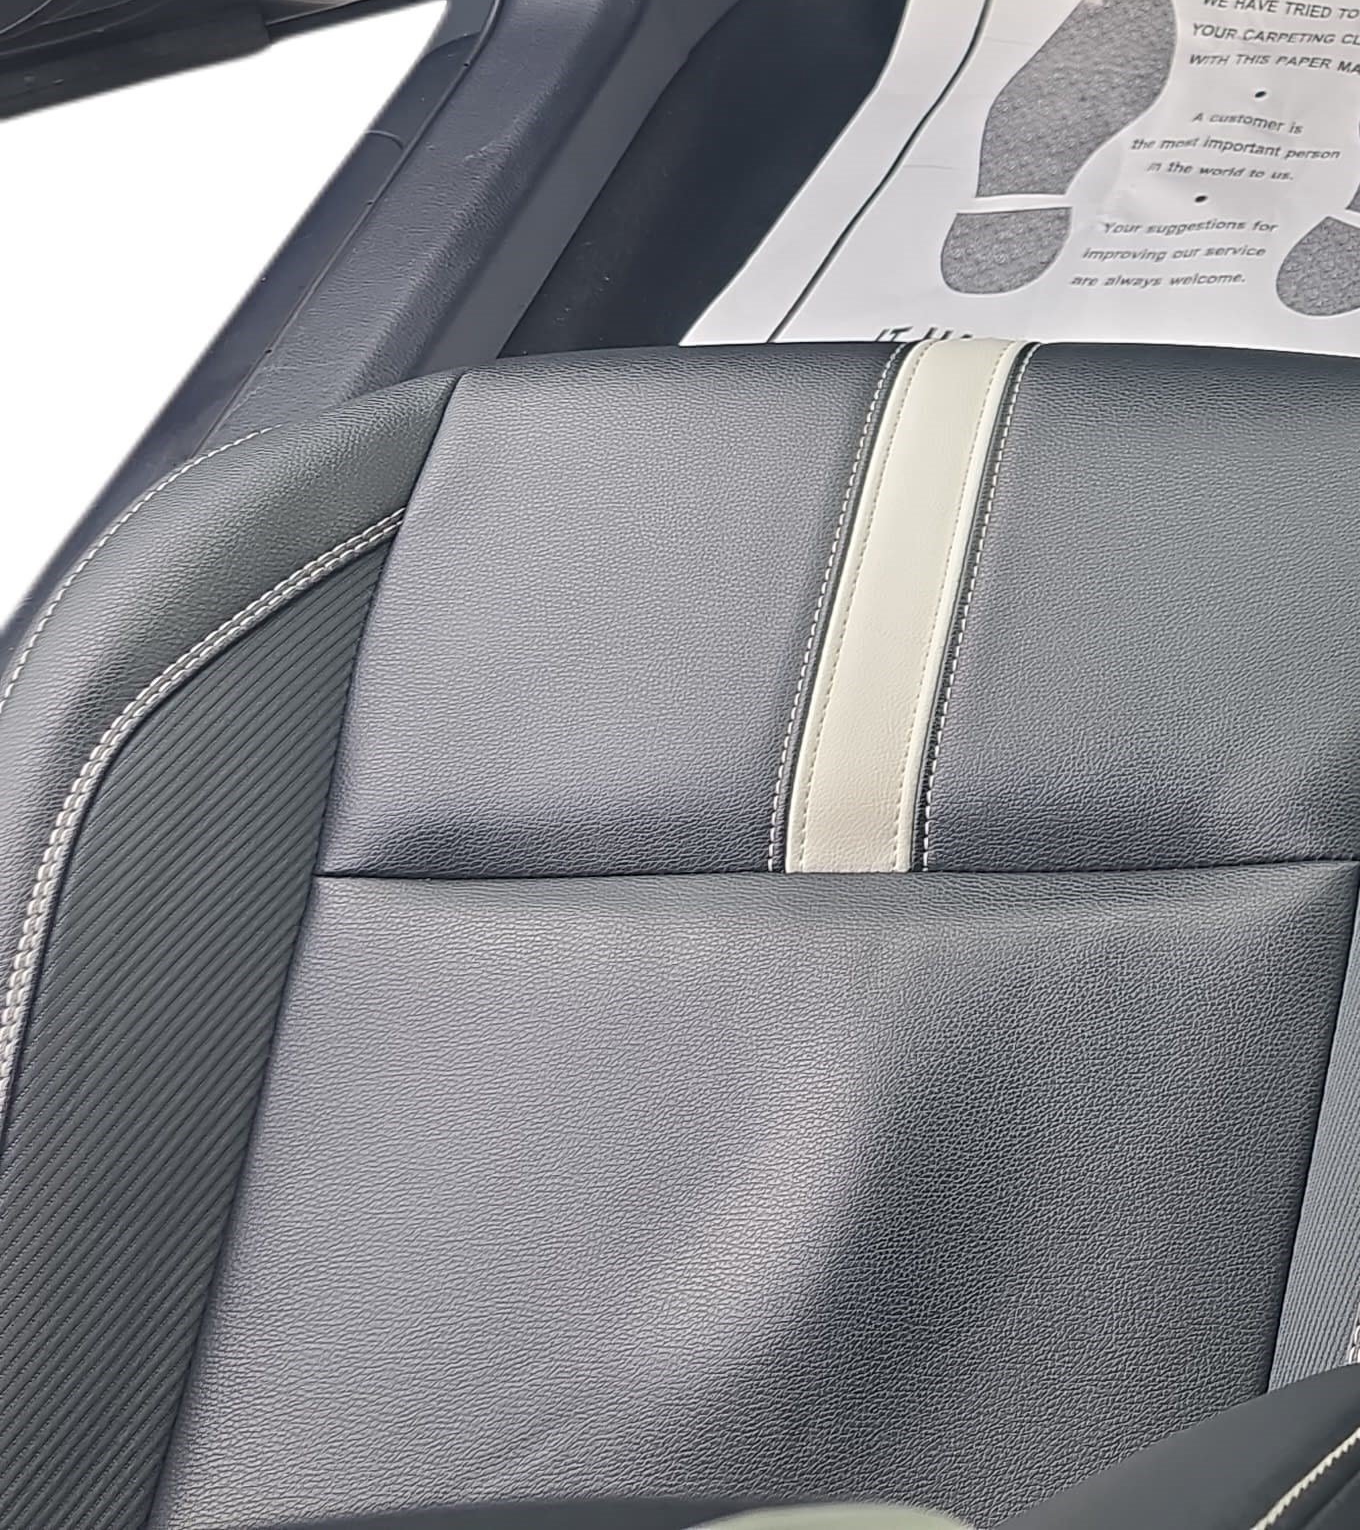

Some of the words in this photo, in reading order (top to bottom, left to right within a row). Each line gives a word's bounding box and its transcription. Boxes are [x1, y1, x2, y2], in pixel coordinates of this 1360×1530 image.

[1285, 1, 1333, 19] TRIED
[1338, 7, 1360, 20] TO
[1192, 22, 1238, 40] YOUR
[1242, 29, 1335, 45] CARPETING
[1189, 53, 1230, 66] WITH
[1235, 54, 1272, 66] THIS
[1275, 55, 1333, 70] PAPER
[1192, 112, 1203, 123] A
[1209, 113, 1285, 131] customer
[1288, 122, 1303, 135] is
[1131, 138, 1156, 151] the
[1160, 137, 1199, 149] most
[1202, 136, 1282, 158] important
[1284, 149, 1340, 160] person
[1148, 162, 1161, 171] in
[1167, 161, 1193, 174] the
[1199, 165, 1244, 177] world
[1249, 169, 1265, 179] to
[1271, 170, 1294, 181] us.
[1103, 221, 1142, 235] Your
[1146, 218, 1246, 236] suggestions
[1252, 220, 1279, 233] for
[1082, 247, 1168, 263] improving
[1172, 248, 1201, 259] our
[1204, 244, 1267, 258] service
[1071, 275, 1099, 287] are
[1104, 273, 1163, 289] always
[1169, 272, 1246, 286] welcome.
